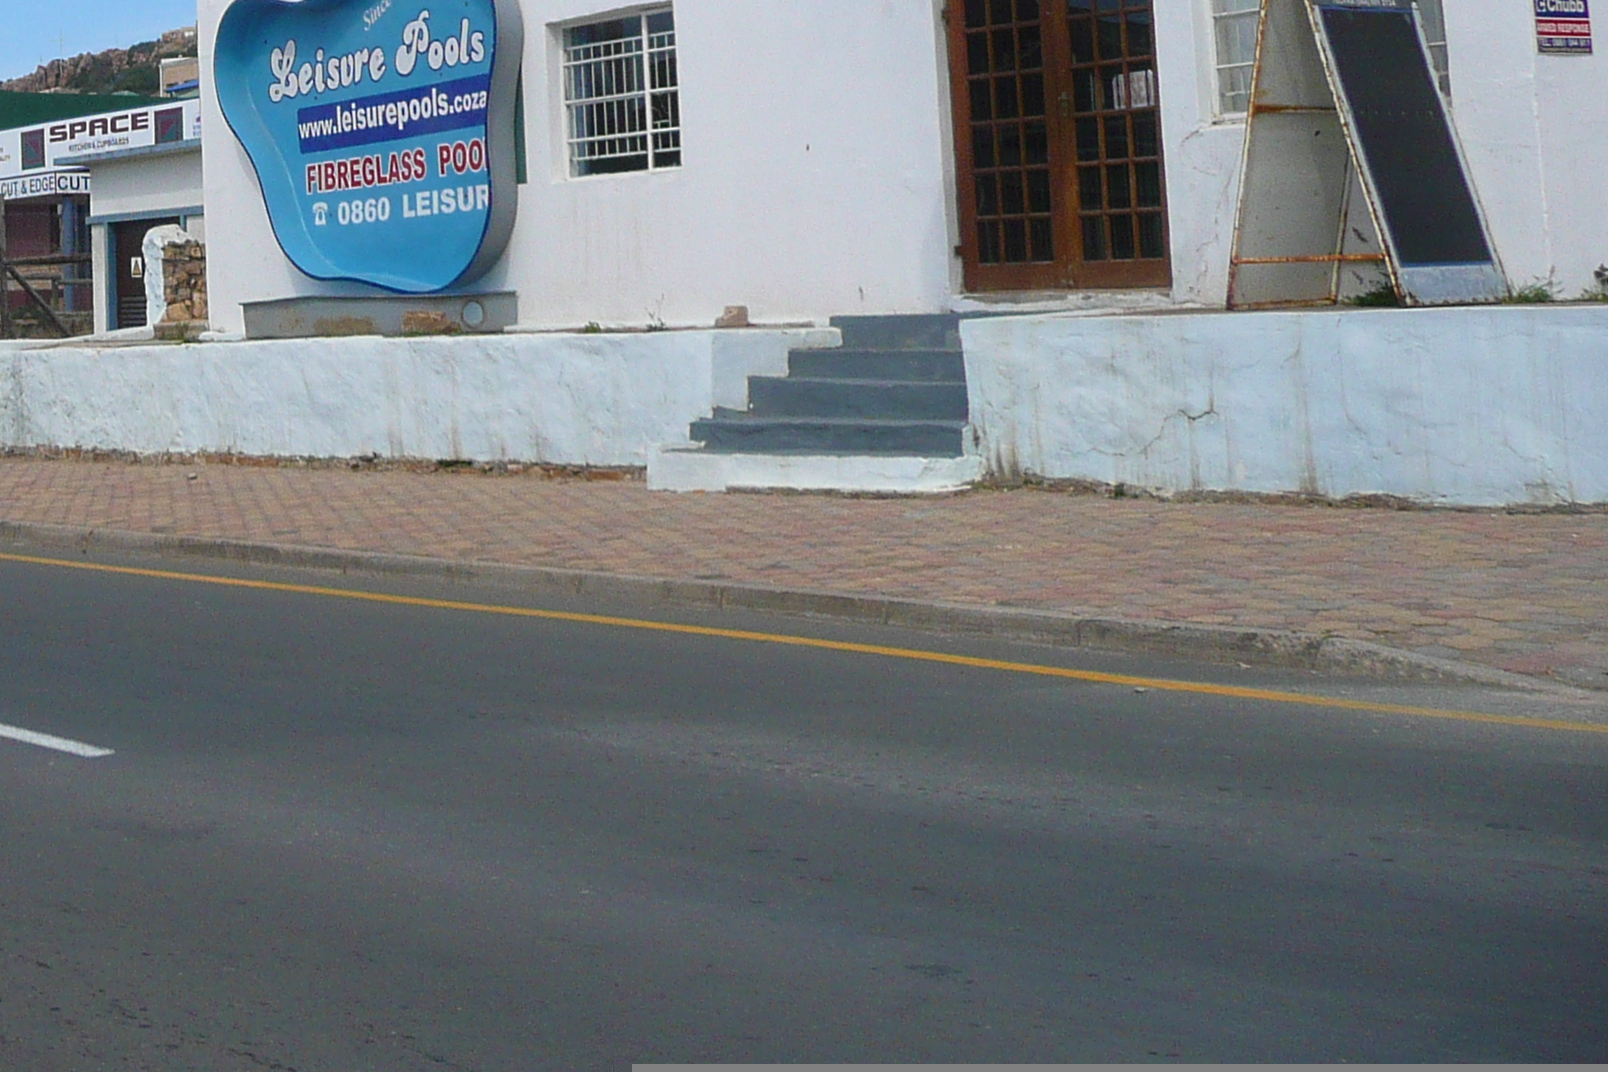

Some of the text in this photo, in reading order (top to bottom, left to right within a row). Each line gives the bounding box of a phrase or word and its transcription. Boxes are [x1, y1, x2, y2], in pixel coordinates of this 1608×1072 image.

[268, 8, 486, 103] Leisure Pools
[48, 110, 150, 144] SPACE
[0, 180, 18, 198] CUT
[21, 179, 28, 195] &
[29, 174, 55, 193] EDGE
[58, 175, 90, 191] CUT
[305, 147, 427, 195] FIBREGLASS
[337, 196, 391, 226] 0860
